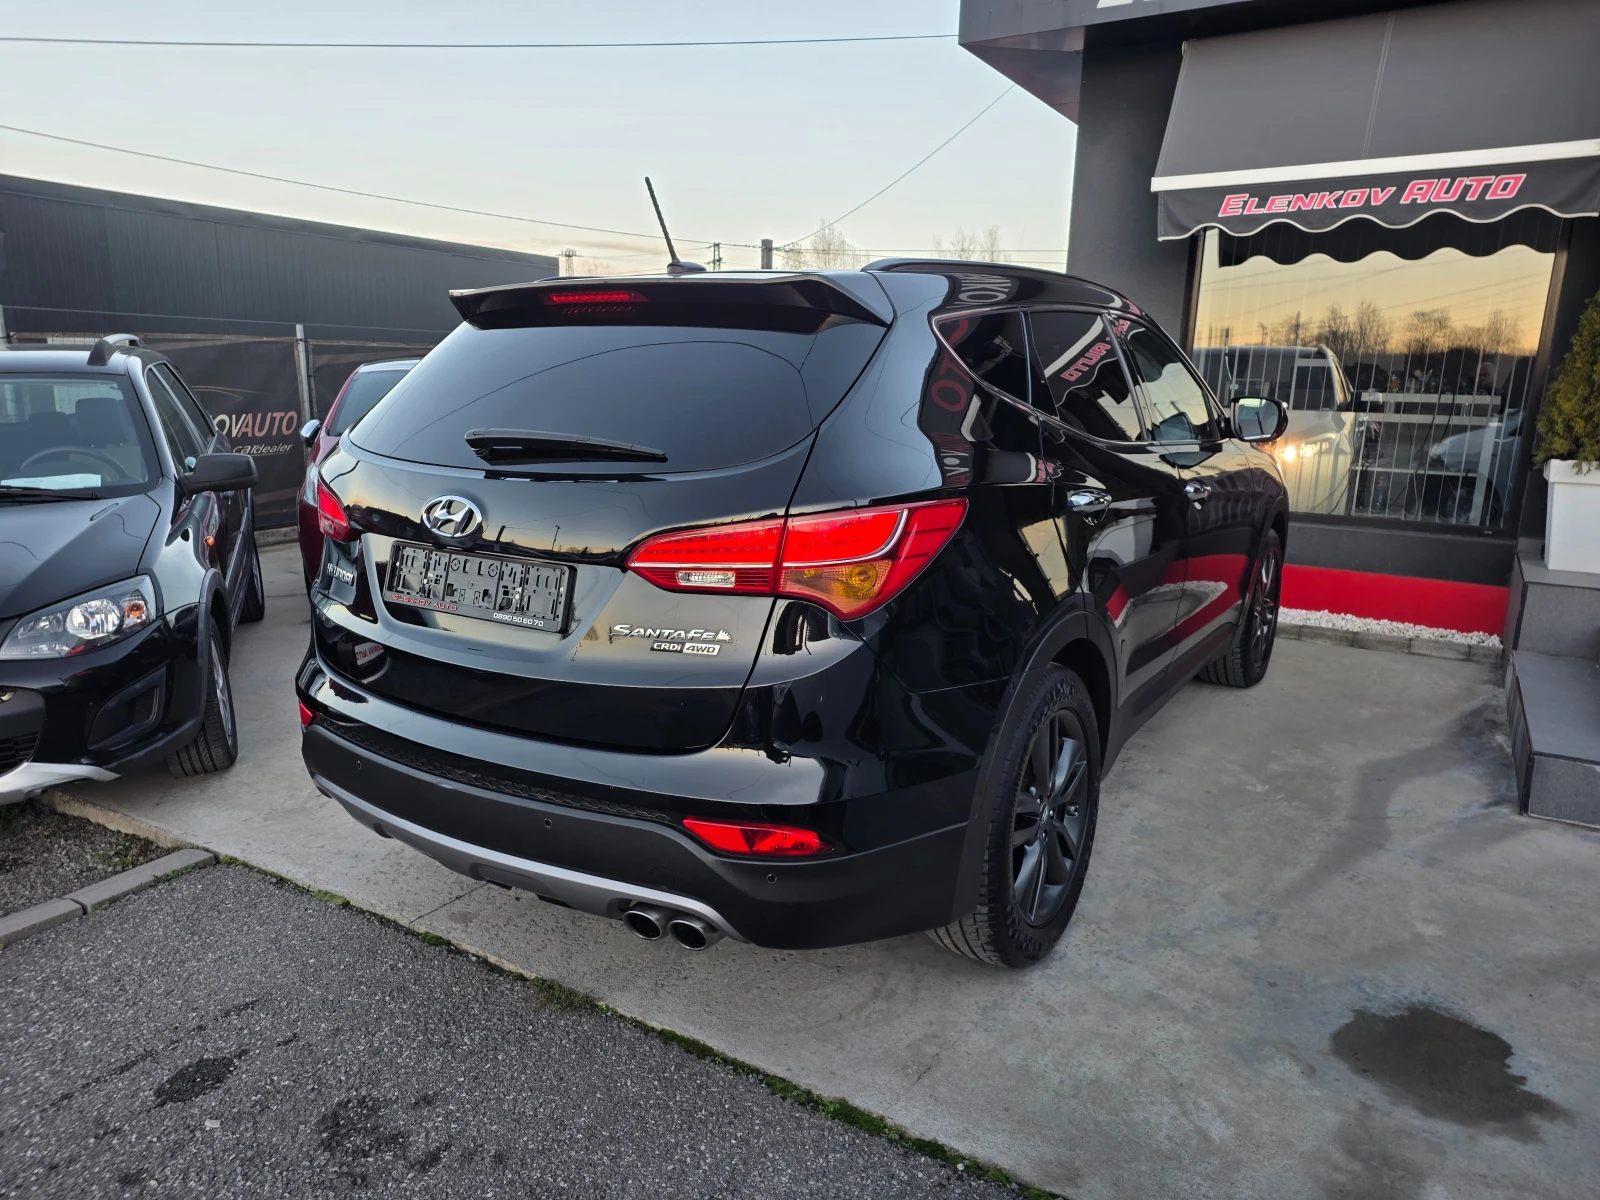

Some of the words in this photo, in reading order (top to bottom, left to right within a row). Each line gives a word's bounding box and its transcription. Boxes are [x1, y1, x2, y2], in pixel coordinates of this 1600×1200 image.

[1218, 186, 1397, 218] ELENKOV
[1400, 173, 1527, 204] AUTO
[433, 602, 458, 611] AUTO
[653, 641, 682, 652] CRDi
[685, 643, 717, 654] 4WD
